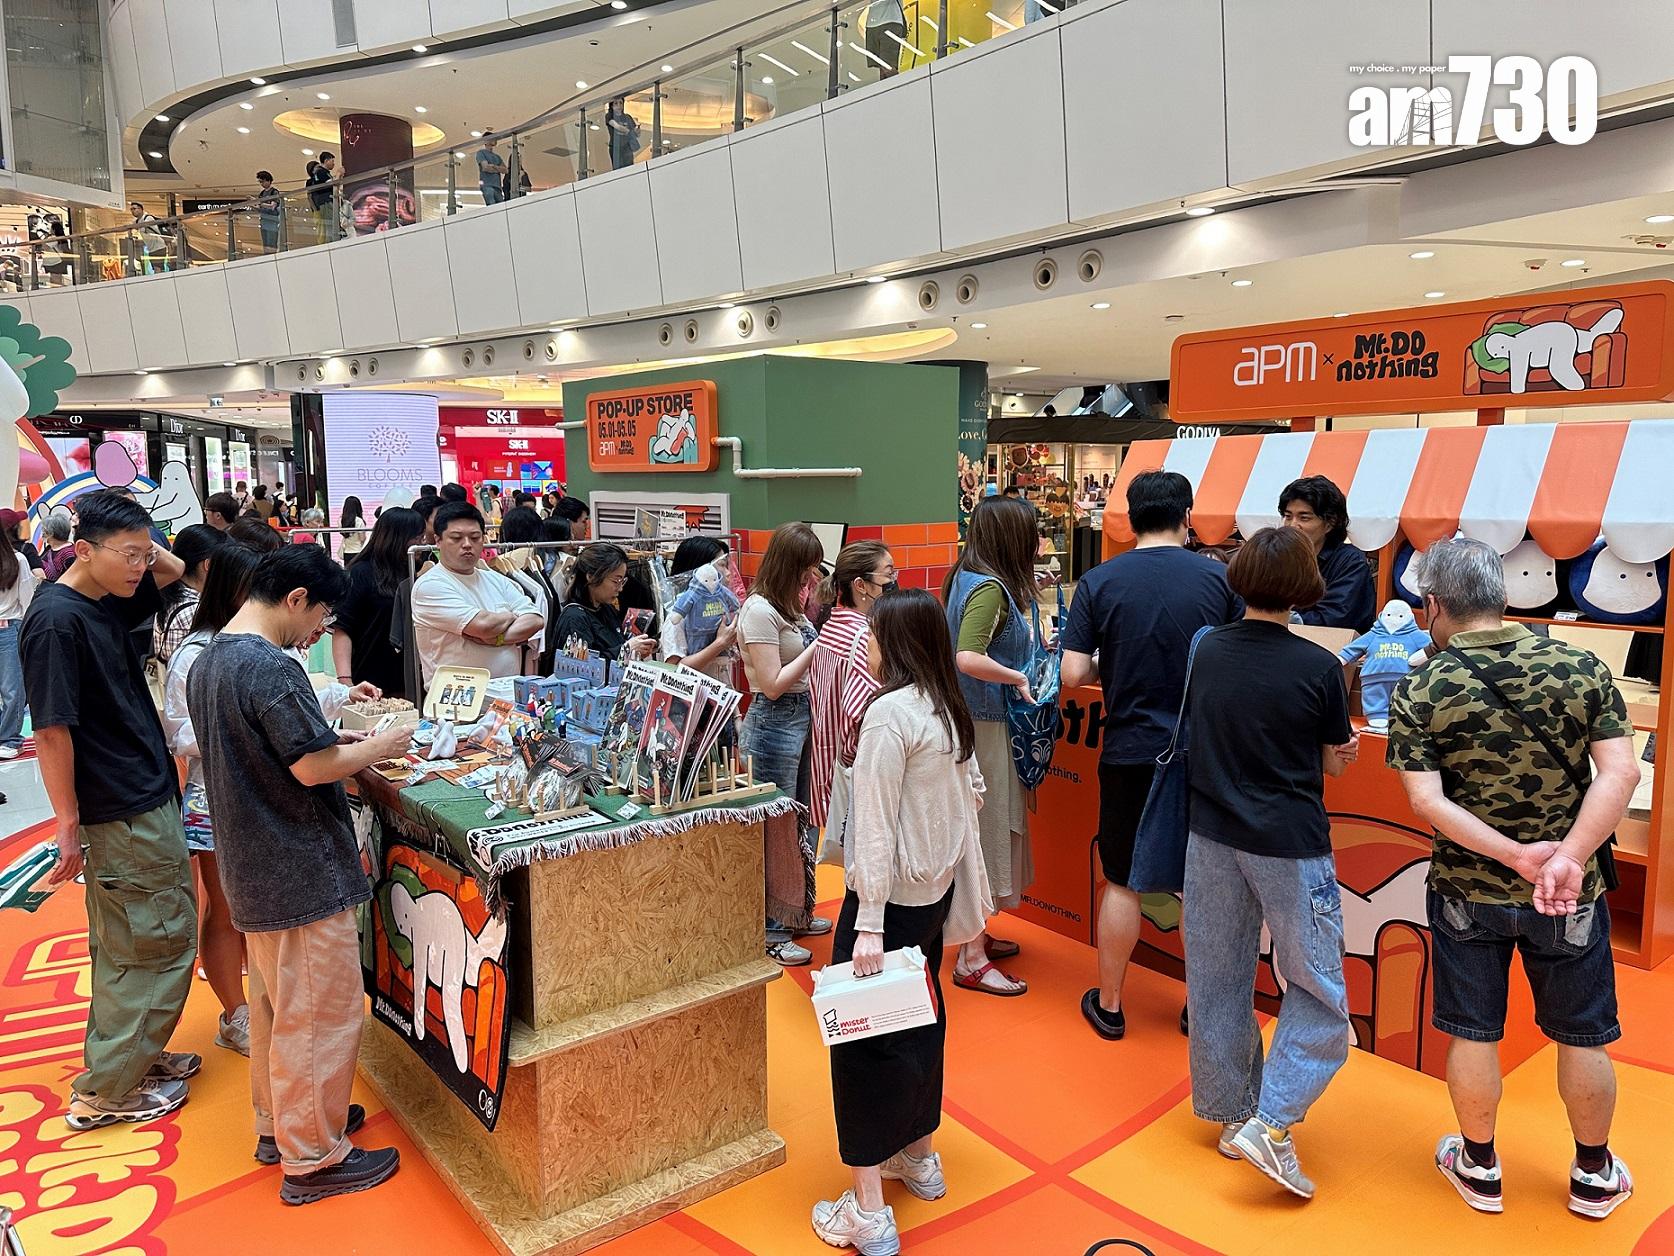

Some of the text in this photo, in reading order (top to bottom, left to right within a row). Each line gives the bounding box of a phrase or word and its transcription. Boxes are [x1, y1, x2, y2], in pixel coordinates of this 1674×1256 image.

[1336, 351, 1440, 382] nothing
[647, 392, 694, 416] STORE
[487, 409, 519, 424] SK-II
[169, 418, 184, 434] Dior
[958, 431, 981, 440] ove,
[357, 468, 423, 481] BLOOMS
